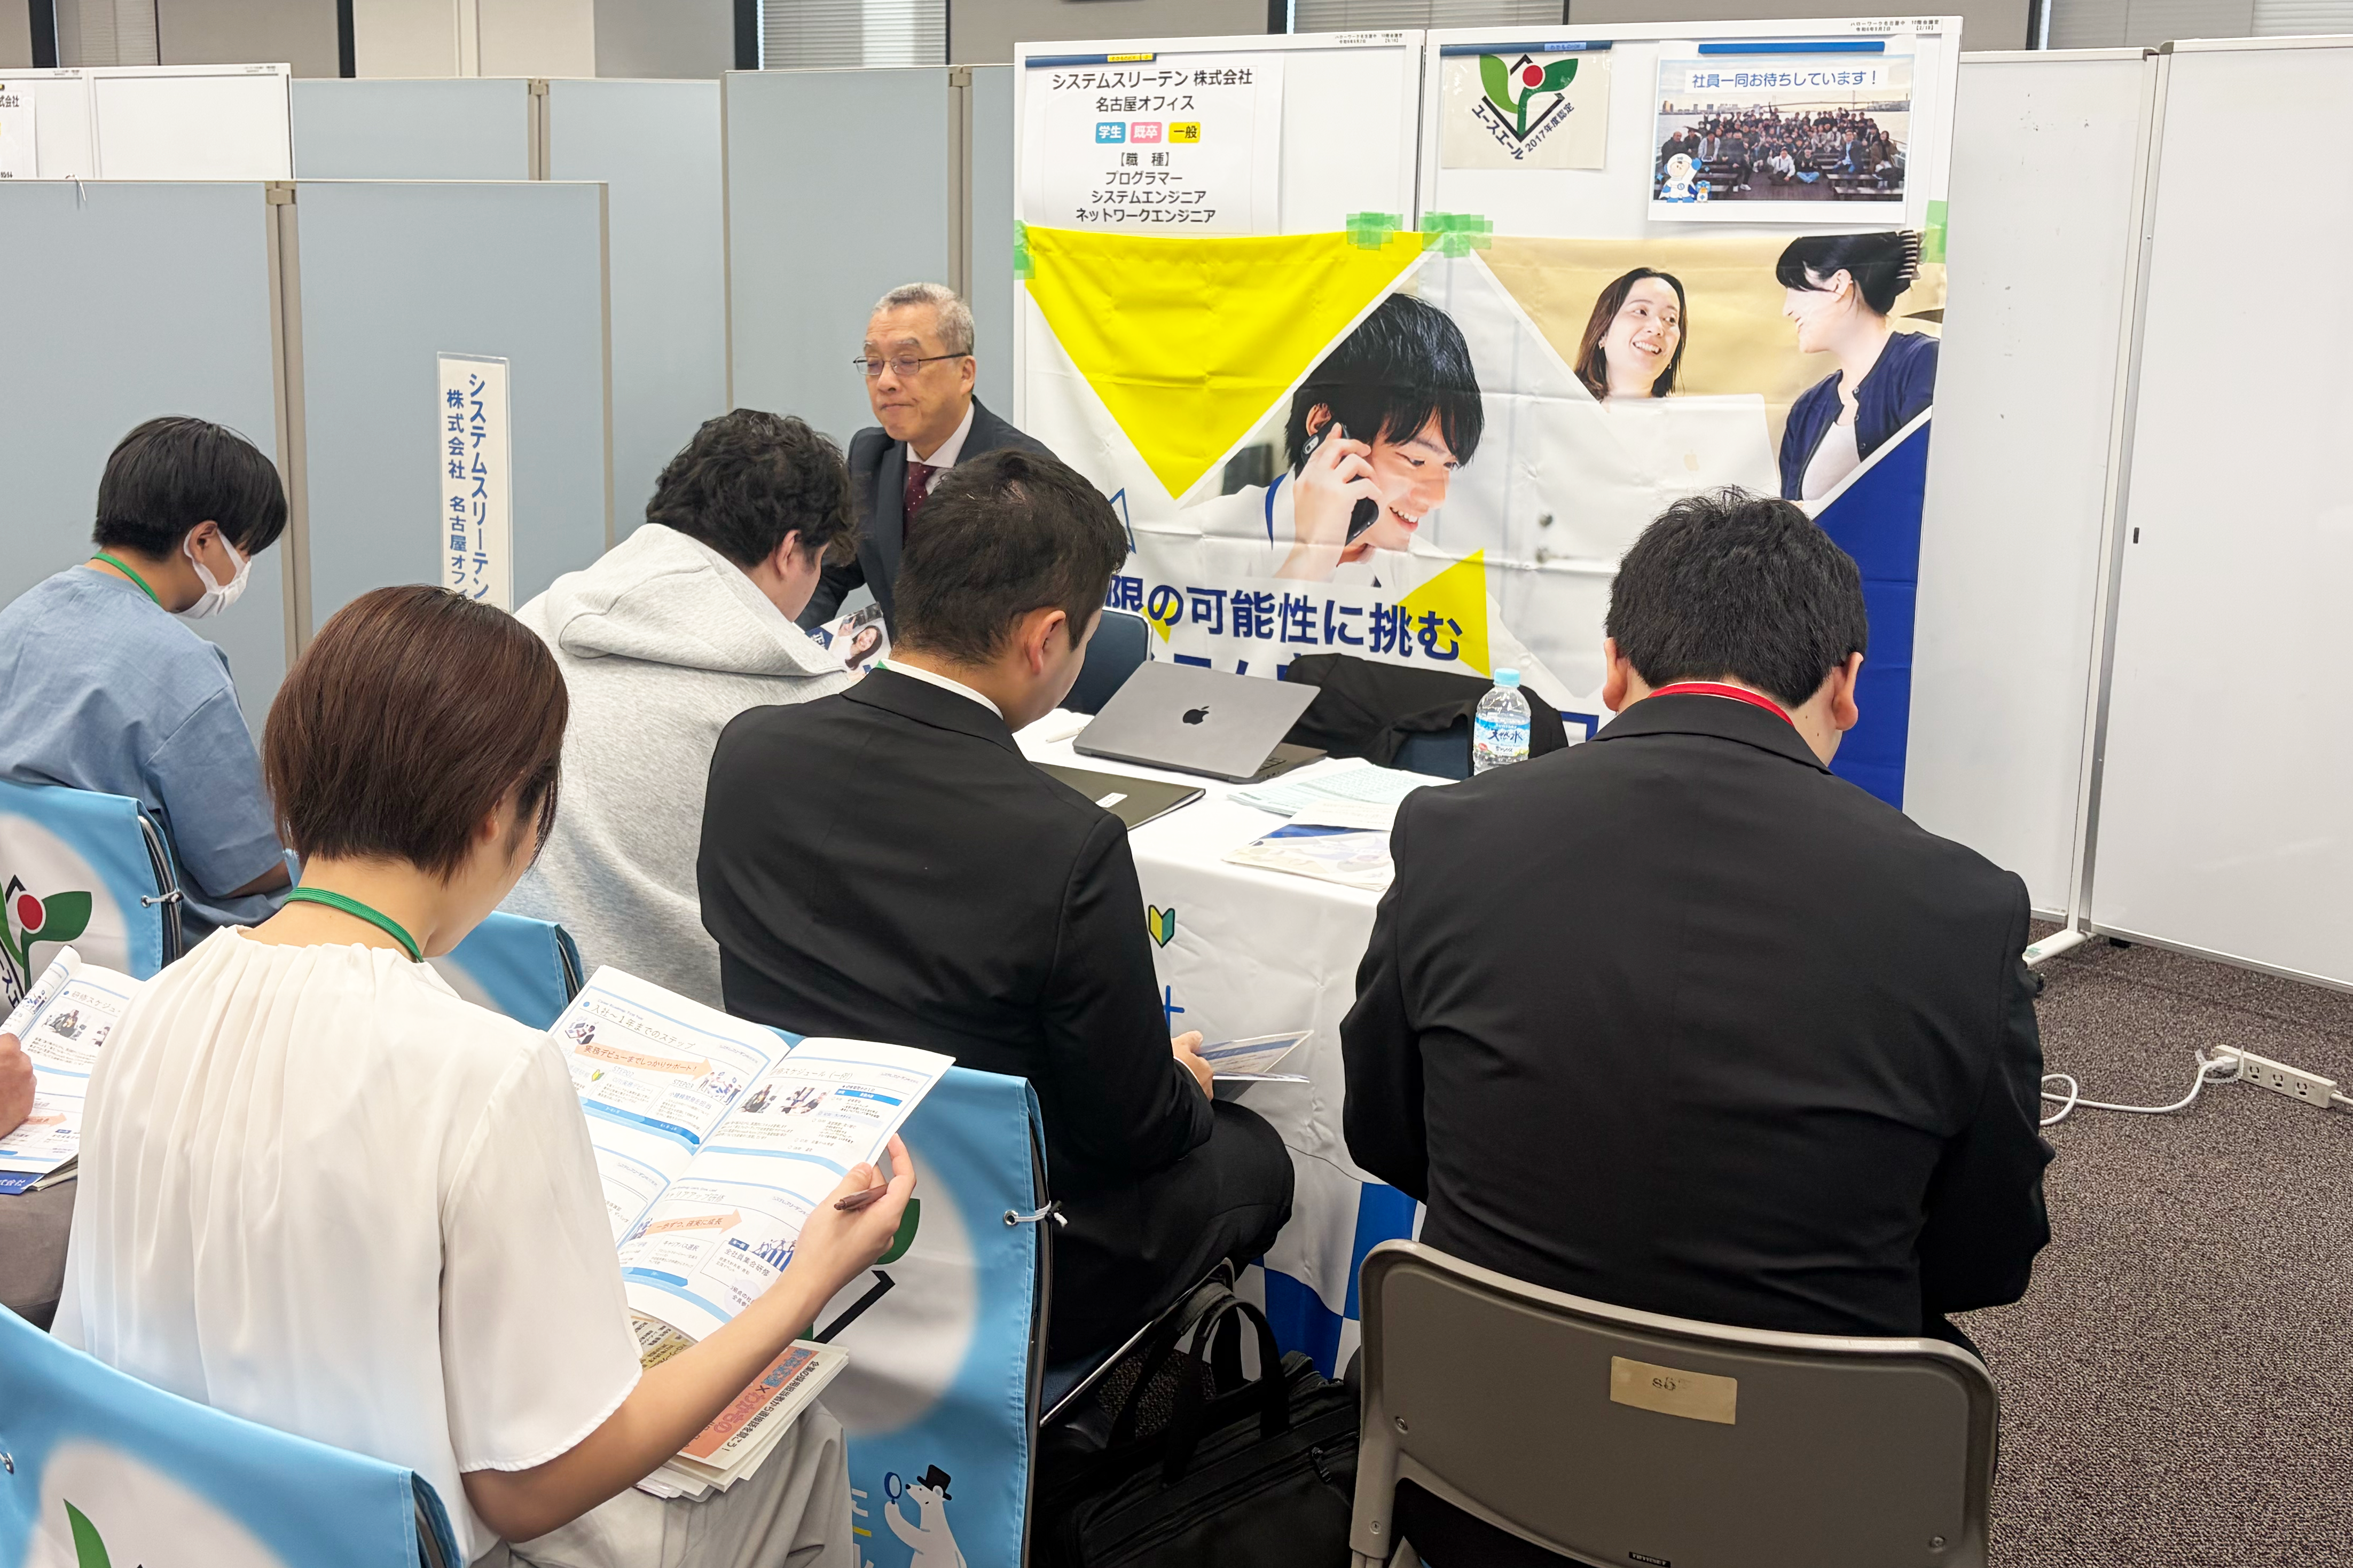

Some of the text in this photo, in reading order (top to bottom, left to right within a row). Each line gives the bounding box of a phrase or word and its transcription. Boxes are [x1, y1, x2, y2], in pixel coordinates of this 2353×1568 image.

[1052, 69, 1252, 90] システムスリーテン 株式会社
[1692, 70, 1876, 88] 社員一同お待ちしています！
[1096, 96, 1194, 112] 名古屋オフィス
[1099, 126, 1121, 139] 学生
[1134, 125, 1158, 139] 既卒
[1173, 125, 1198, 139] 一般
[1472, 105, 1524, 160] ユースエール
[1525, 103, 1574, 152] 2017年度認定
[1106, 171, 1183, 185] プログラマー
[1092, 190, 1207, 204] システムエンジニア
[1076, 208, 1215, 223] ネットワークエンジニア
[446, 389, 466, 480] 株式会社
[468, 373, 489, 599] システムスリーテン
[725, 1249, 770, 1277] 全社員集合研修
